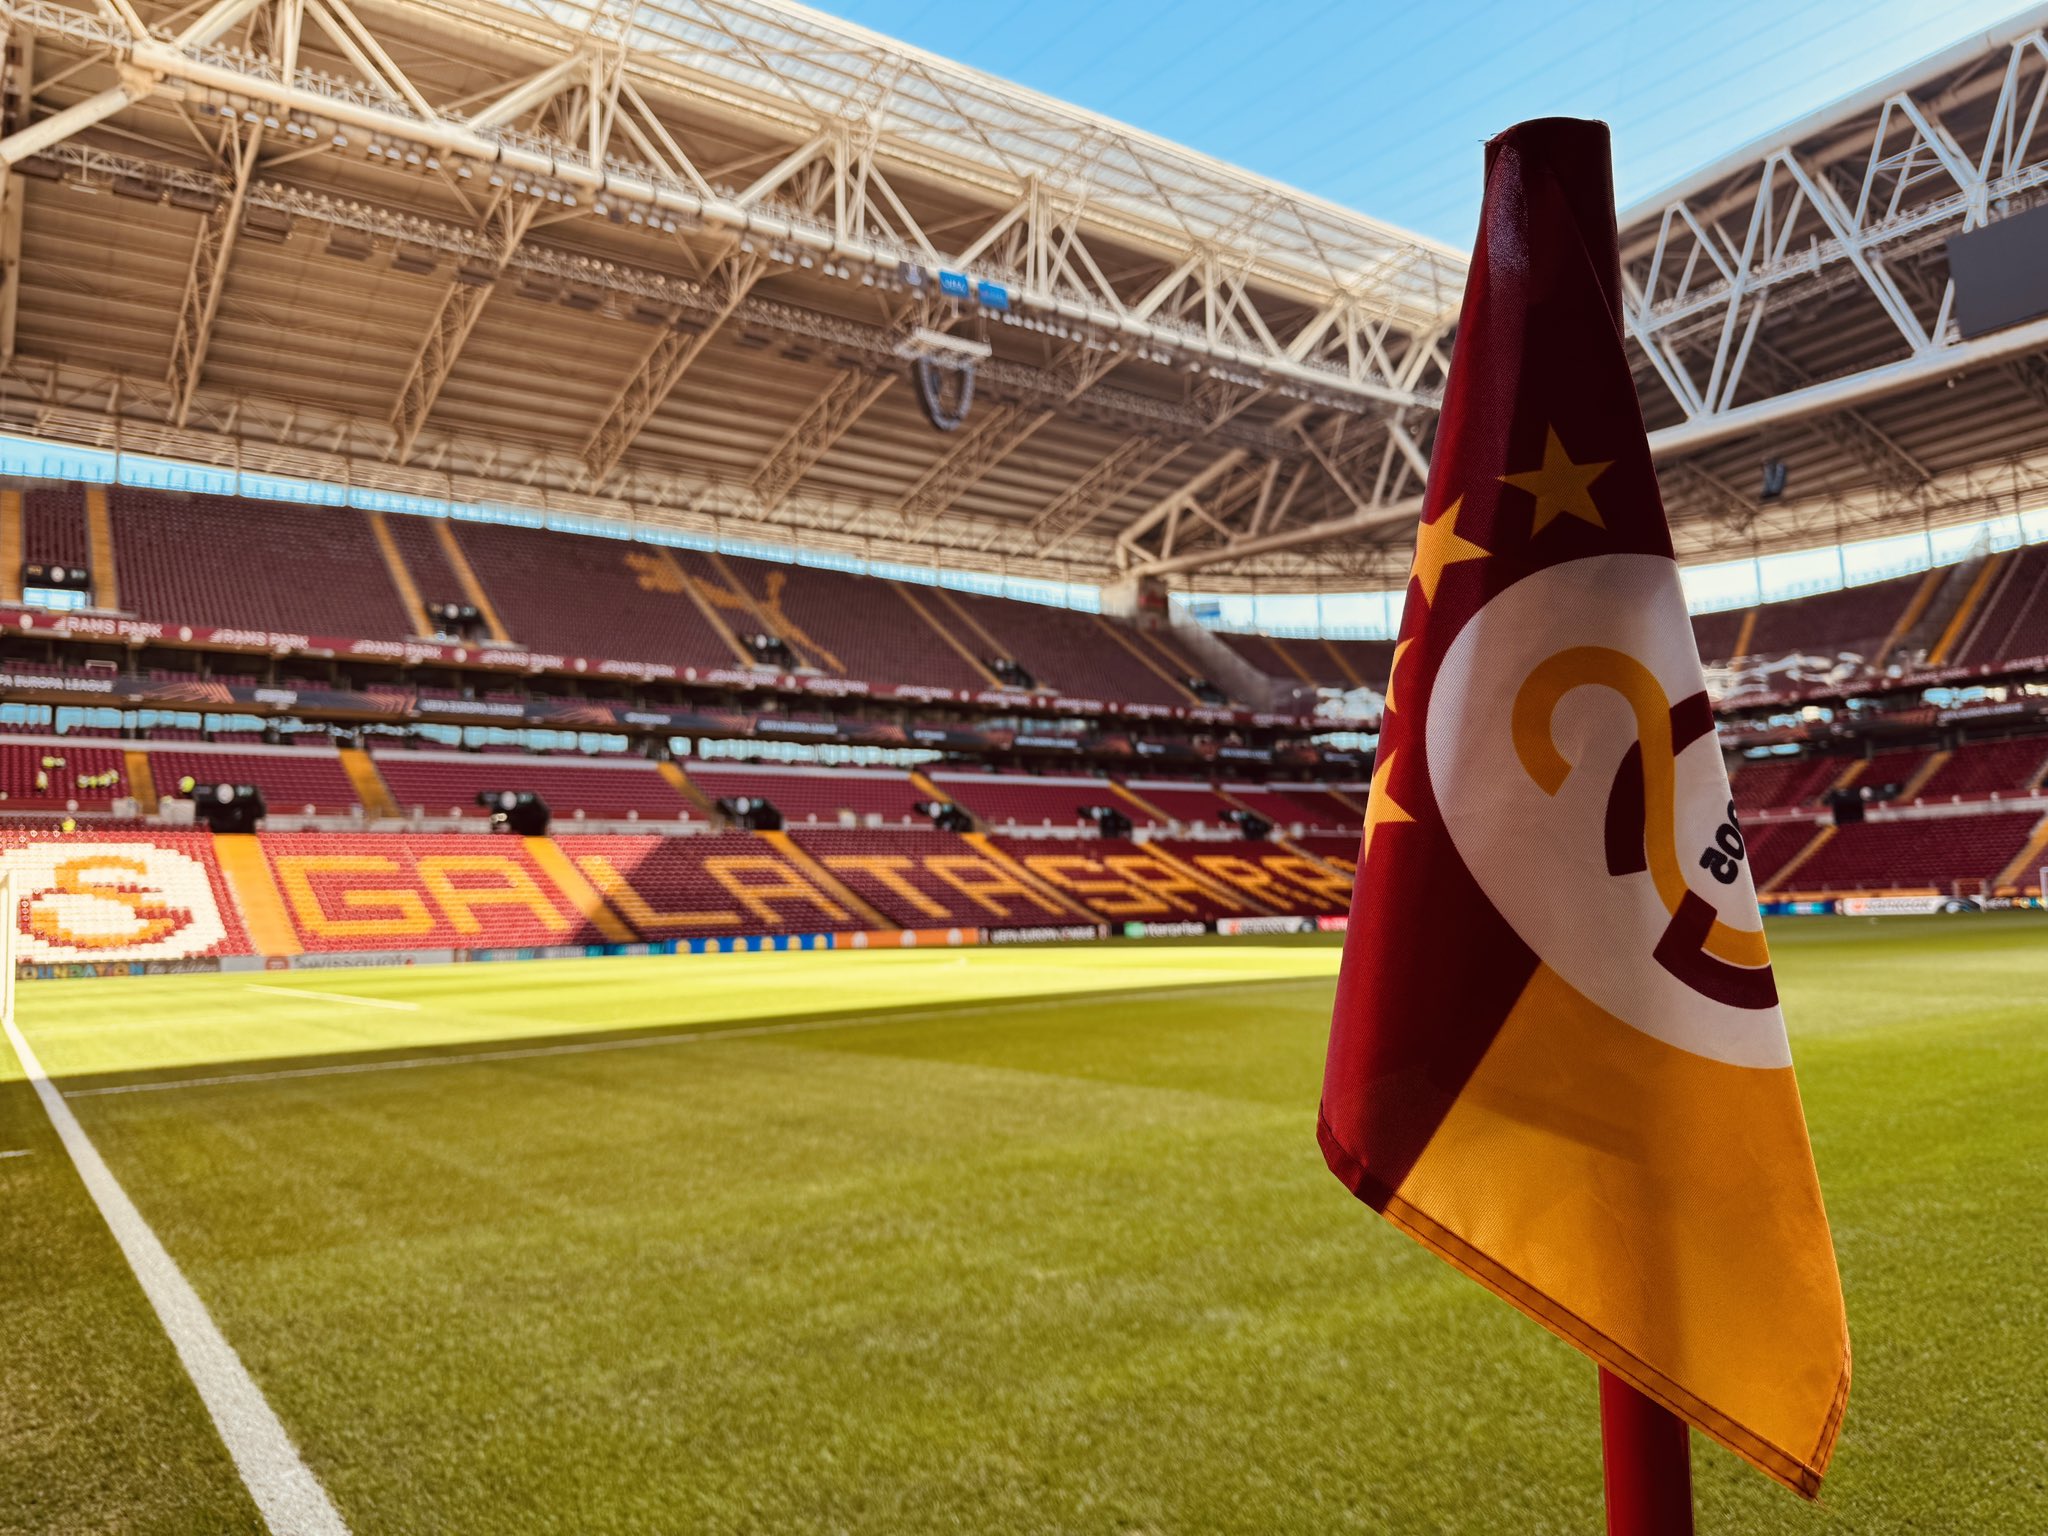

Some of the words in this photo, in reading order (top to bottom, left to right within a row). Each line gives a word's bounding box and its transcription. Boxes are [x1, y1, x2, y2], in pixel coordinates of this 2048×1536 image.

[67, 616, 116, 635] RAMS
[117, 620, 163, 638] PARK
[222, 628, 267, 647] RAMS
[14, 675, 64, 690] EUROPA
[64, 678, 113, 693] LEAGUE
[275, 854, 1357, 937] GALATASARA
[16, 963, 146, 981] OUNDATION
